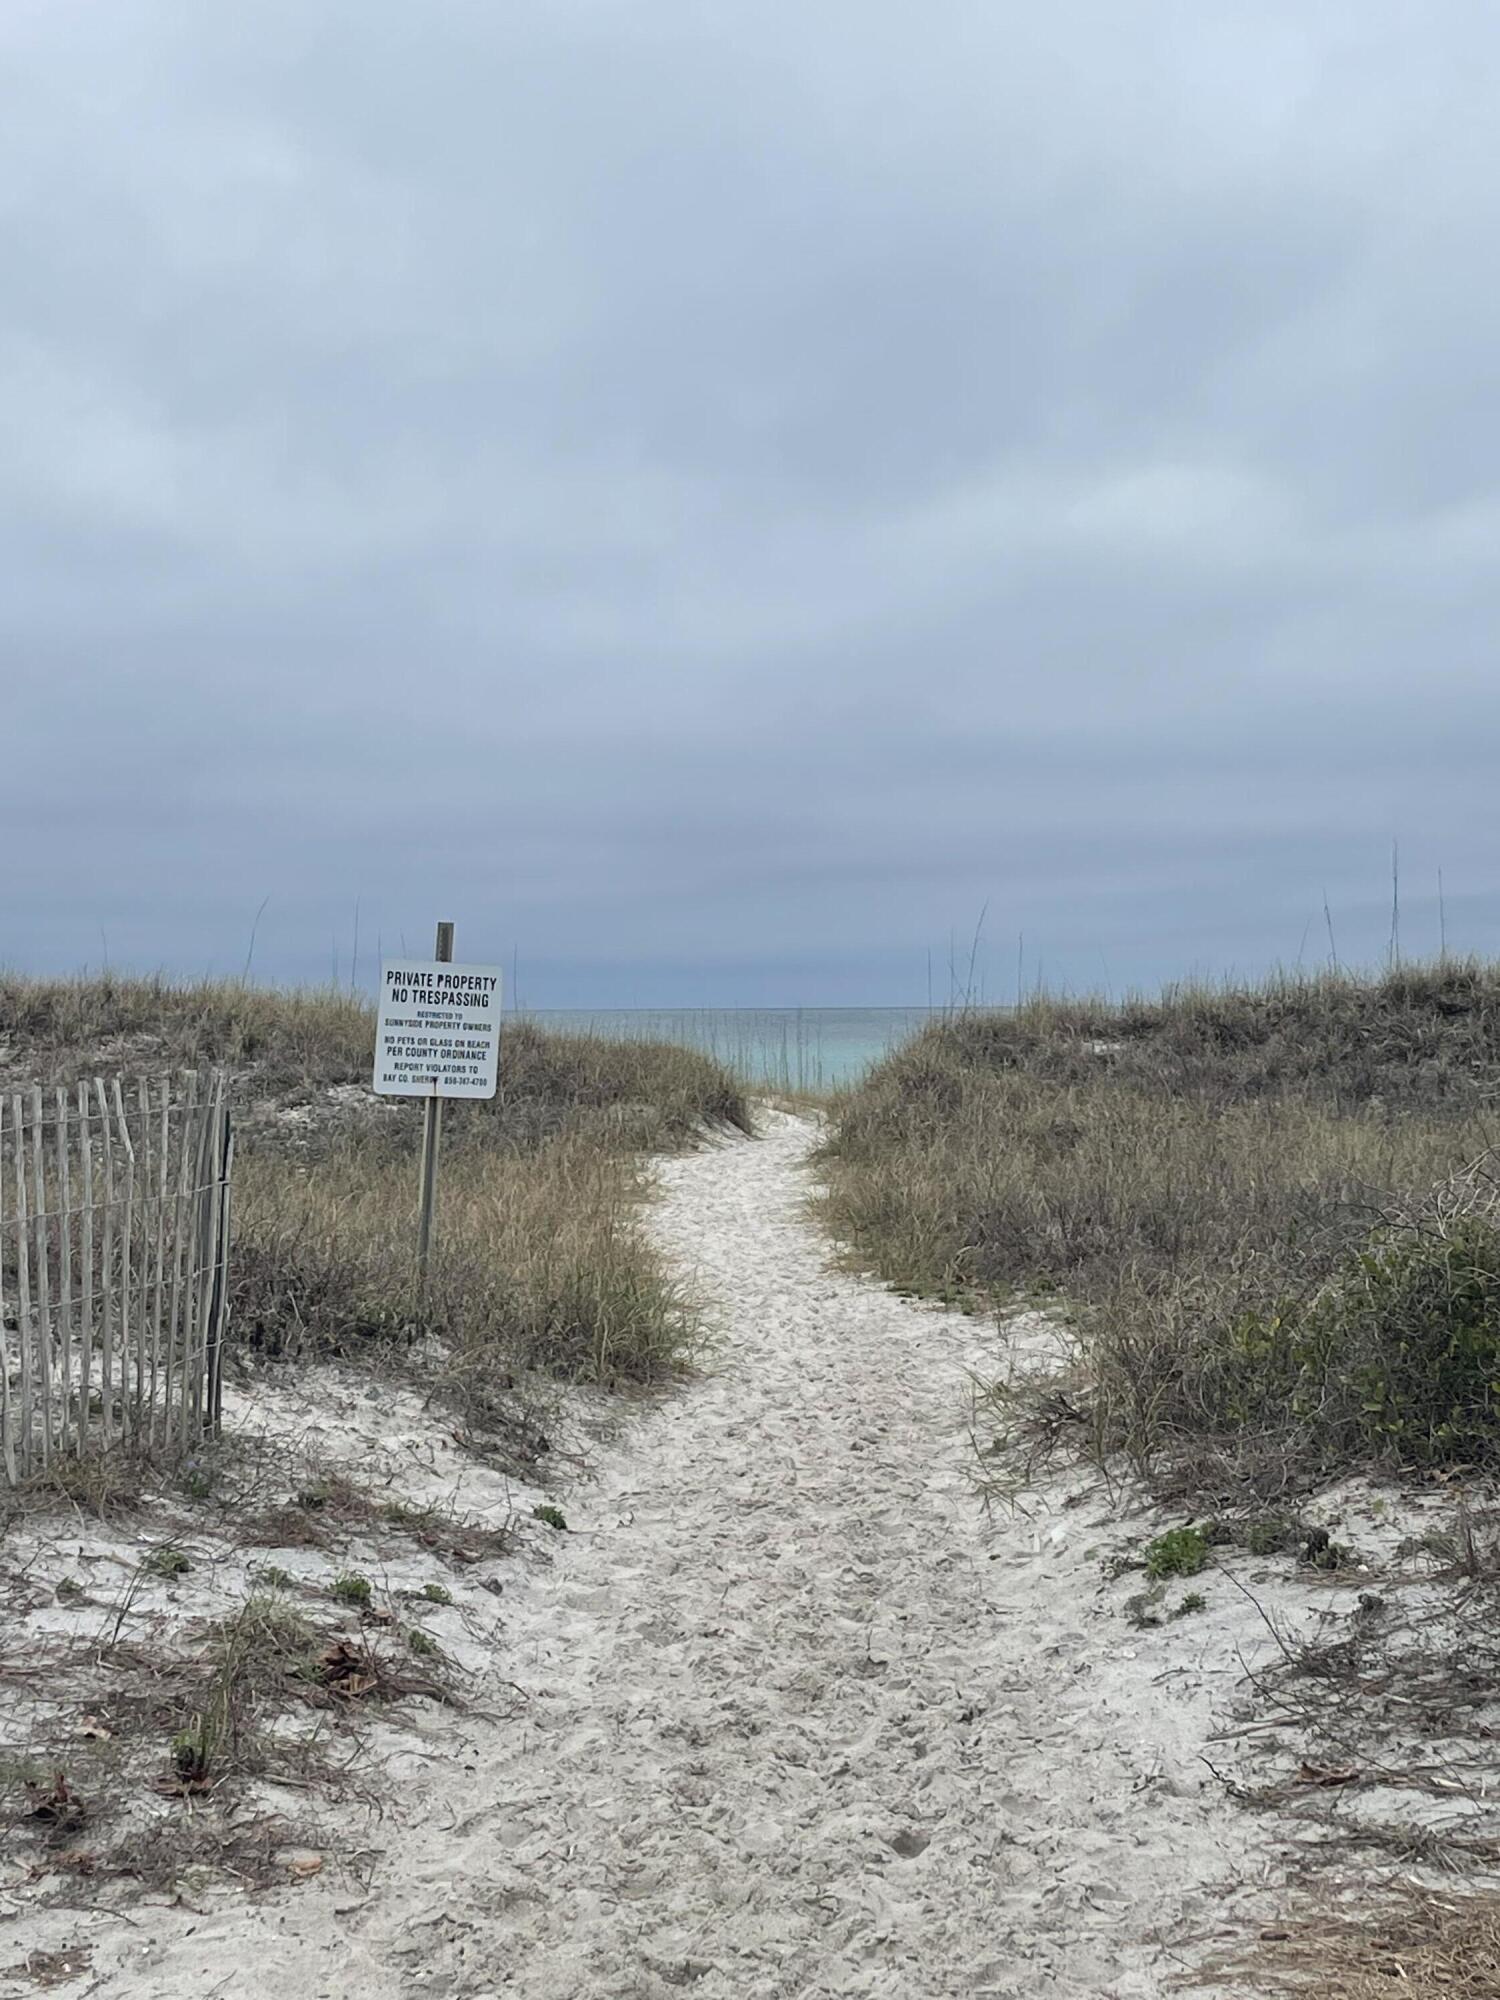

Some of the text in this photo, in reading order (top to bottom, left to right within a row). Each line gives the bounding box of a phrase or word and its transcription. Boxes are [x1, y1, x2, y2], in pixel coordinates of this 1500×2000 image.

[386, 970, 497, 992] PRIVATE PROPERTY
[391, 988, 489, 1008] NO TRESPASSING
[417, 1011, 453, 1020] RESTRICTED
[385, 1018, 492, 1033] SUNNYSIDE PROPERTY OWNERS
[384, 1035, 491, 1049] NO PETS OR GLASS ON BEACH
[386, 1046, 487, 1061] PER COUNTY ORDINANCE
[394, 1062, 479, 1075] REPORT VIOLATORS TO
[383, 1073, 396, 1083] BAY
